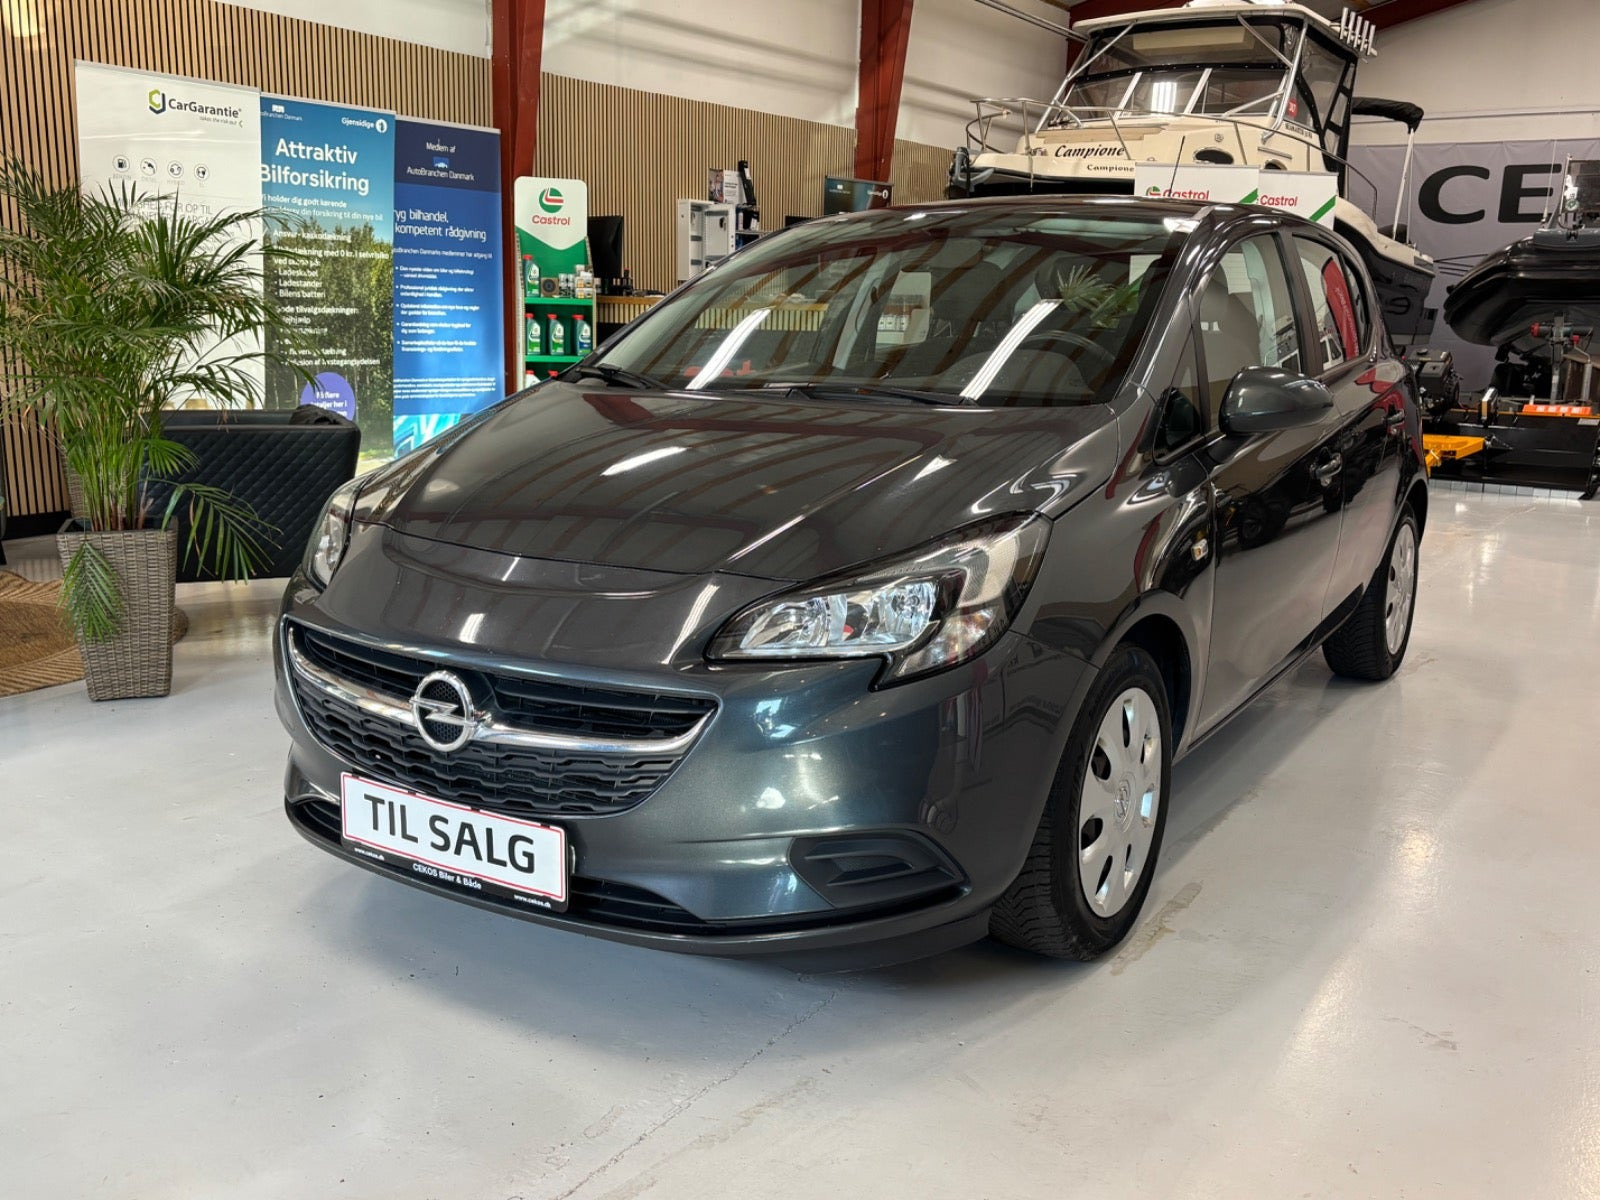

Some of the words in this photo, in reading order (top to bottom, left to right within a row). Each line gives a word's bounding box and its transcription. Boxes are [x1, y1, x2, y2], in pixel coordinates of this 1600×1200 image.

[168, 98, 239, 118] CarGarantie
[341, 117, 375, 129] Gjensidige
[275, 138, 358, 164] Attraktiv
[426, 141, 448, 152] Medlem
[1054, 144, 1126, 159] Campione
[1086, 163, 1135, 172] Campione
[260, 164, 370, 196] Bilforsikring
[449, 170, 475, 181] Danmark
[1162, 189, 1210, 200] Castrol
[1260, 194, 1298, 207] Castrol
[409, 208, 449, 223] bilhandel,
[532, 214, 571, 226] Castrol
[395, 222, 442, 237] kompetent
[445, 225, 487, 242] rådgivning
[363, 793, 419, 844] TIL
[429, 813, 535, 874] SALG
[412, 862, 438, 877] CEKOS
[438, 870, 455, 882] Biler
[456, 875, 461, 884] &
[463, 877, 482, 889] Både
